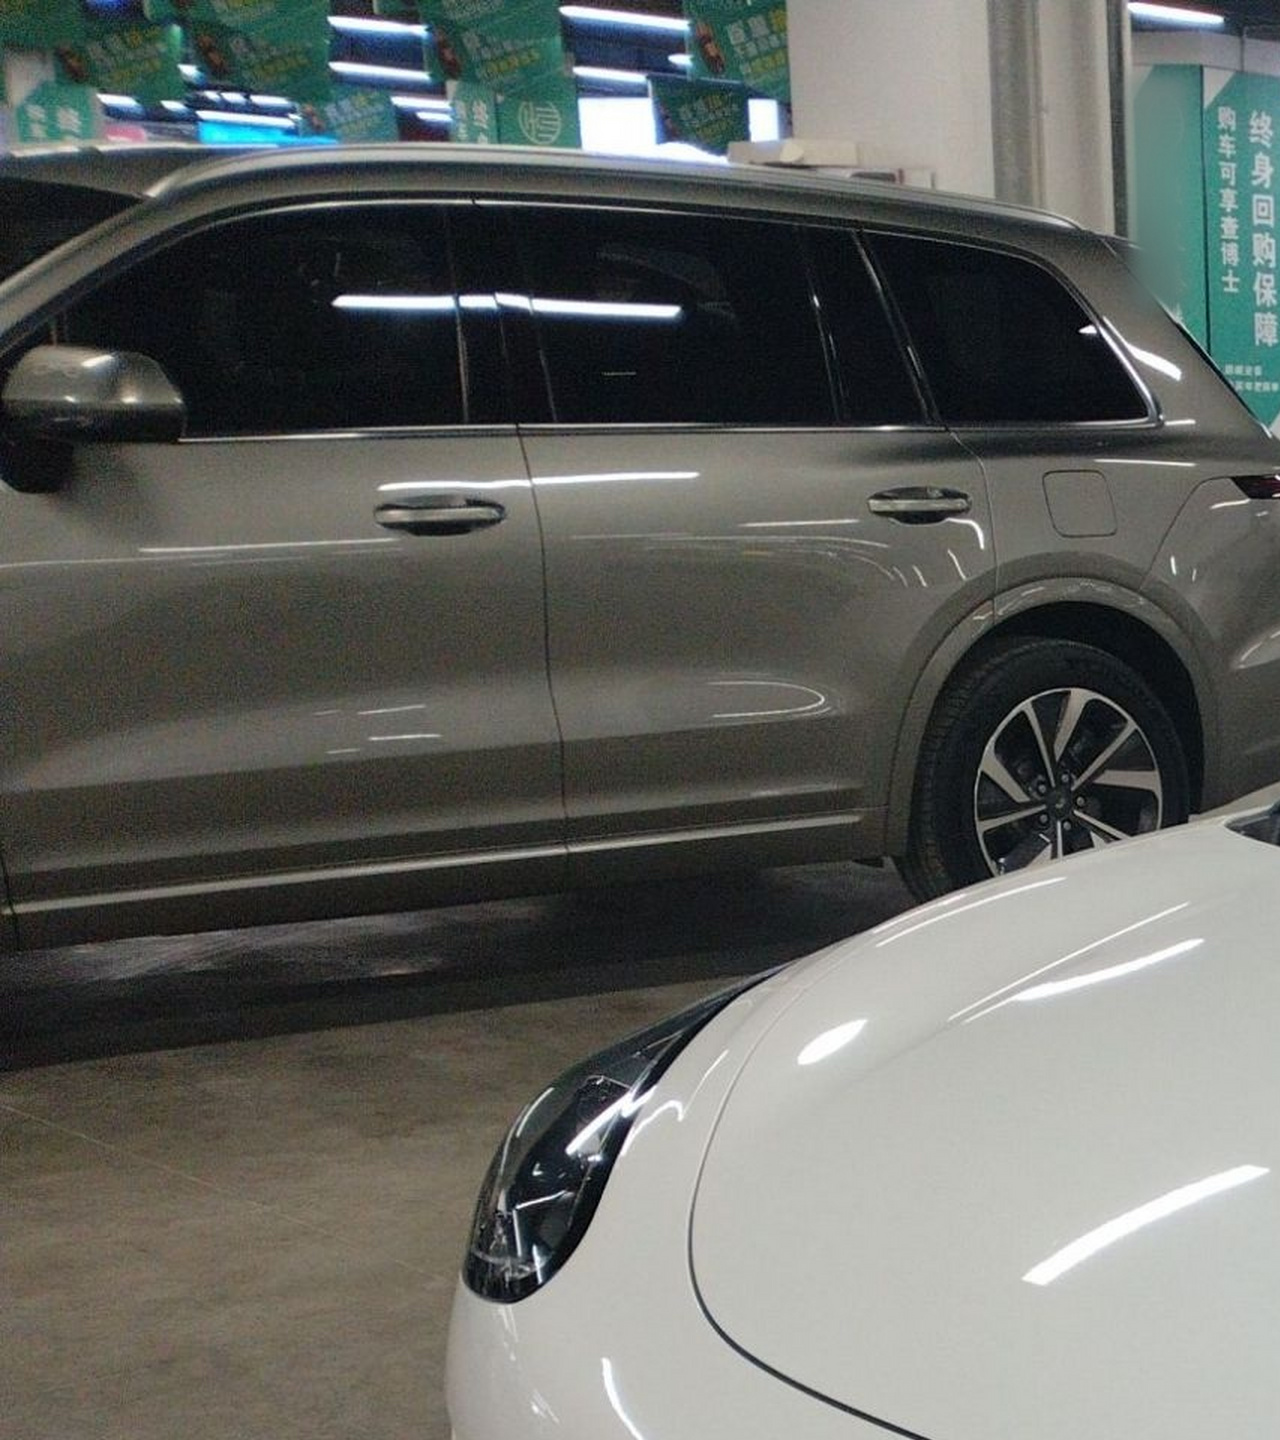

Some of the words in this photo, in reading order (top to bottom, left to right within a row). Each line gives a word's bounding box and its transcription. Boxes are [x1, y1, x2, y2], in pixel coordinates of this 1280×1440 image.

[1217, 106, 1240, 293] 购车可享查博士
[1249, 110, 1279, 347] 终身回购保障
